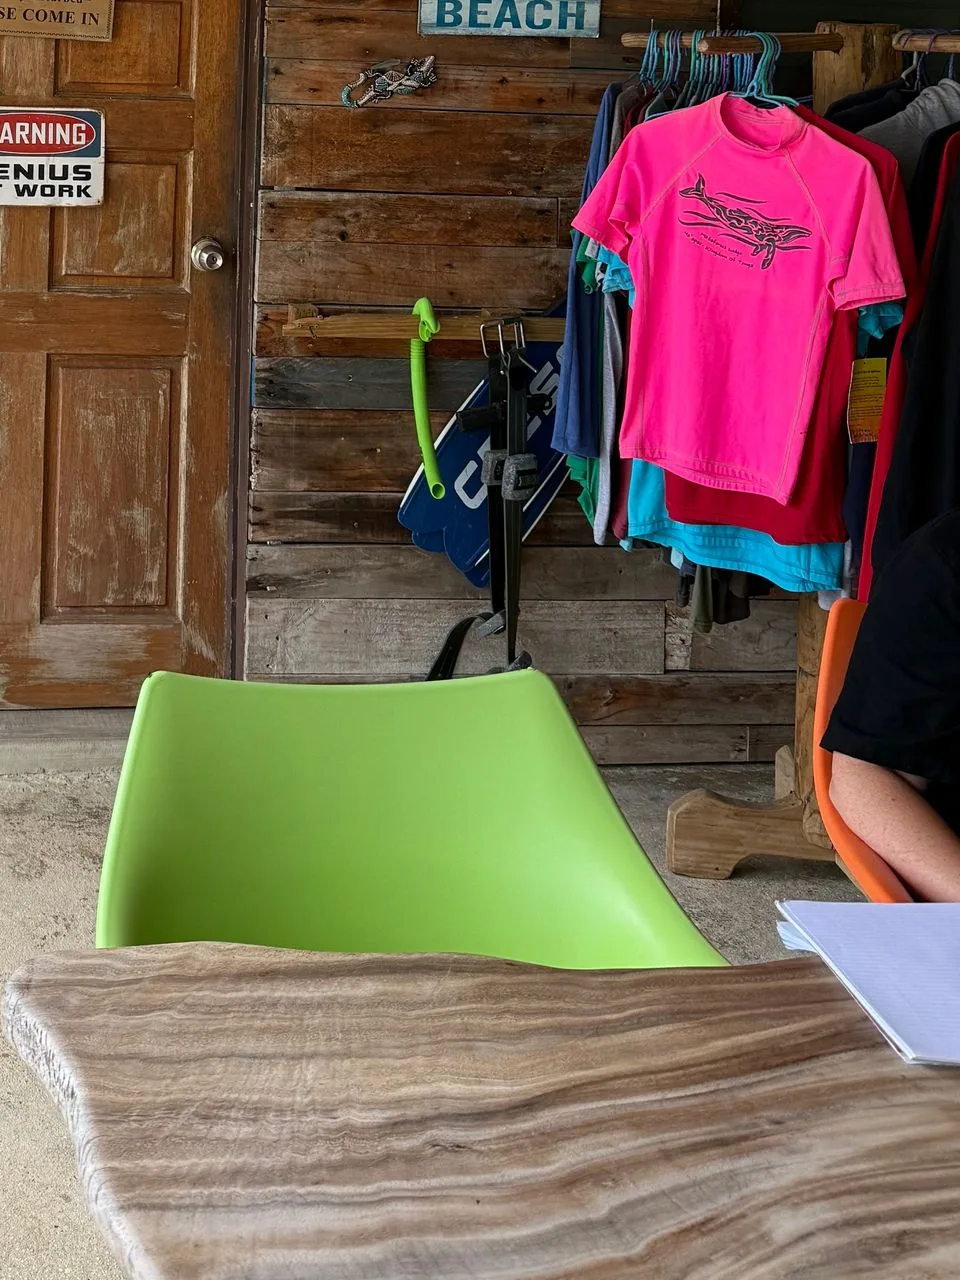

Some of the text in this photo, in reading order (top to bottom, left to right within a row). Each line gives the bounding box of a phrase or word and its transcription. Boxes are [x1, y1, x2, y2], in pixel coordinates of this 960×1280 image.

[22, 8, 75, 25] COME
[77, 12, 100, 26] IN
[14, 183, 93, 198] WORK
